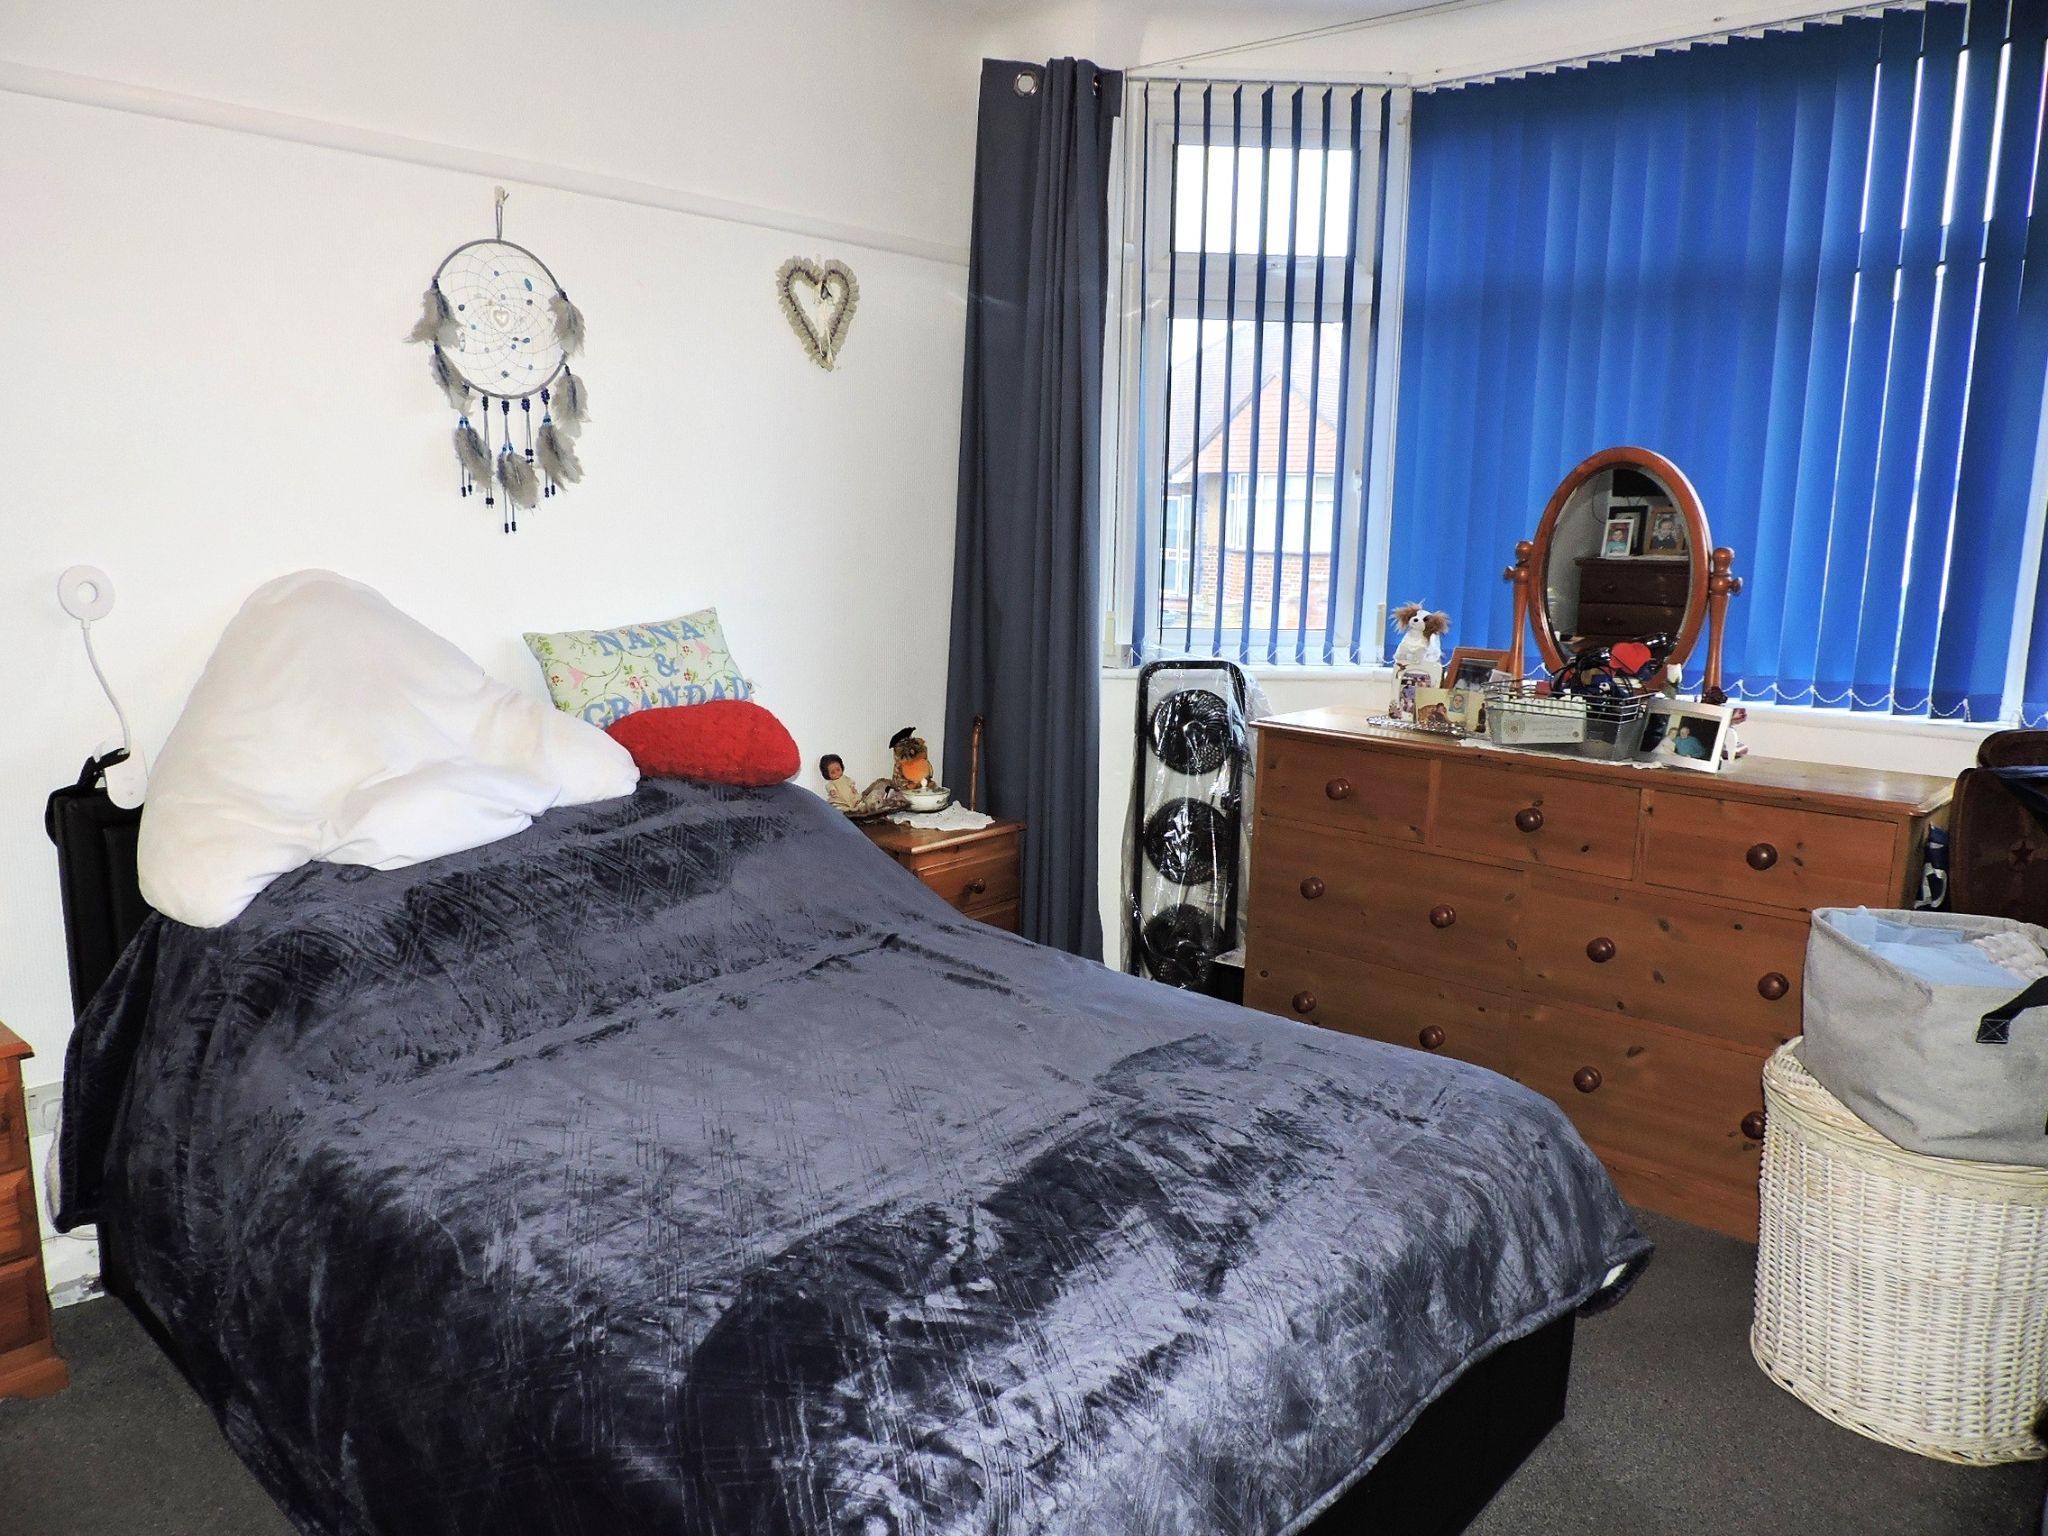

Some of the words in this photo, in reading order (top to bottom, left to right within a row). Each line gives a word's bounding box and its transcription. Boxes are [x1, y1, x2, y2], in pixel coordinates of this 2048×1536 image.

[591, 621, 704, 656] NANA
[654, 653, 680, 677] &
[583, 676, 750, 729] GRANDAD
